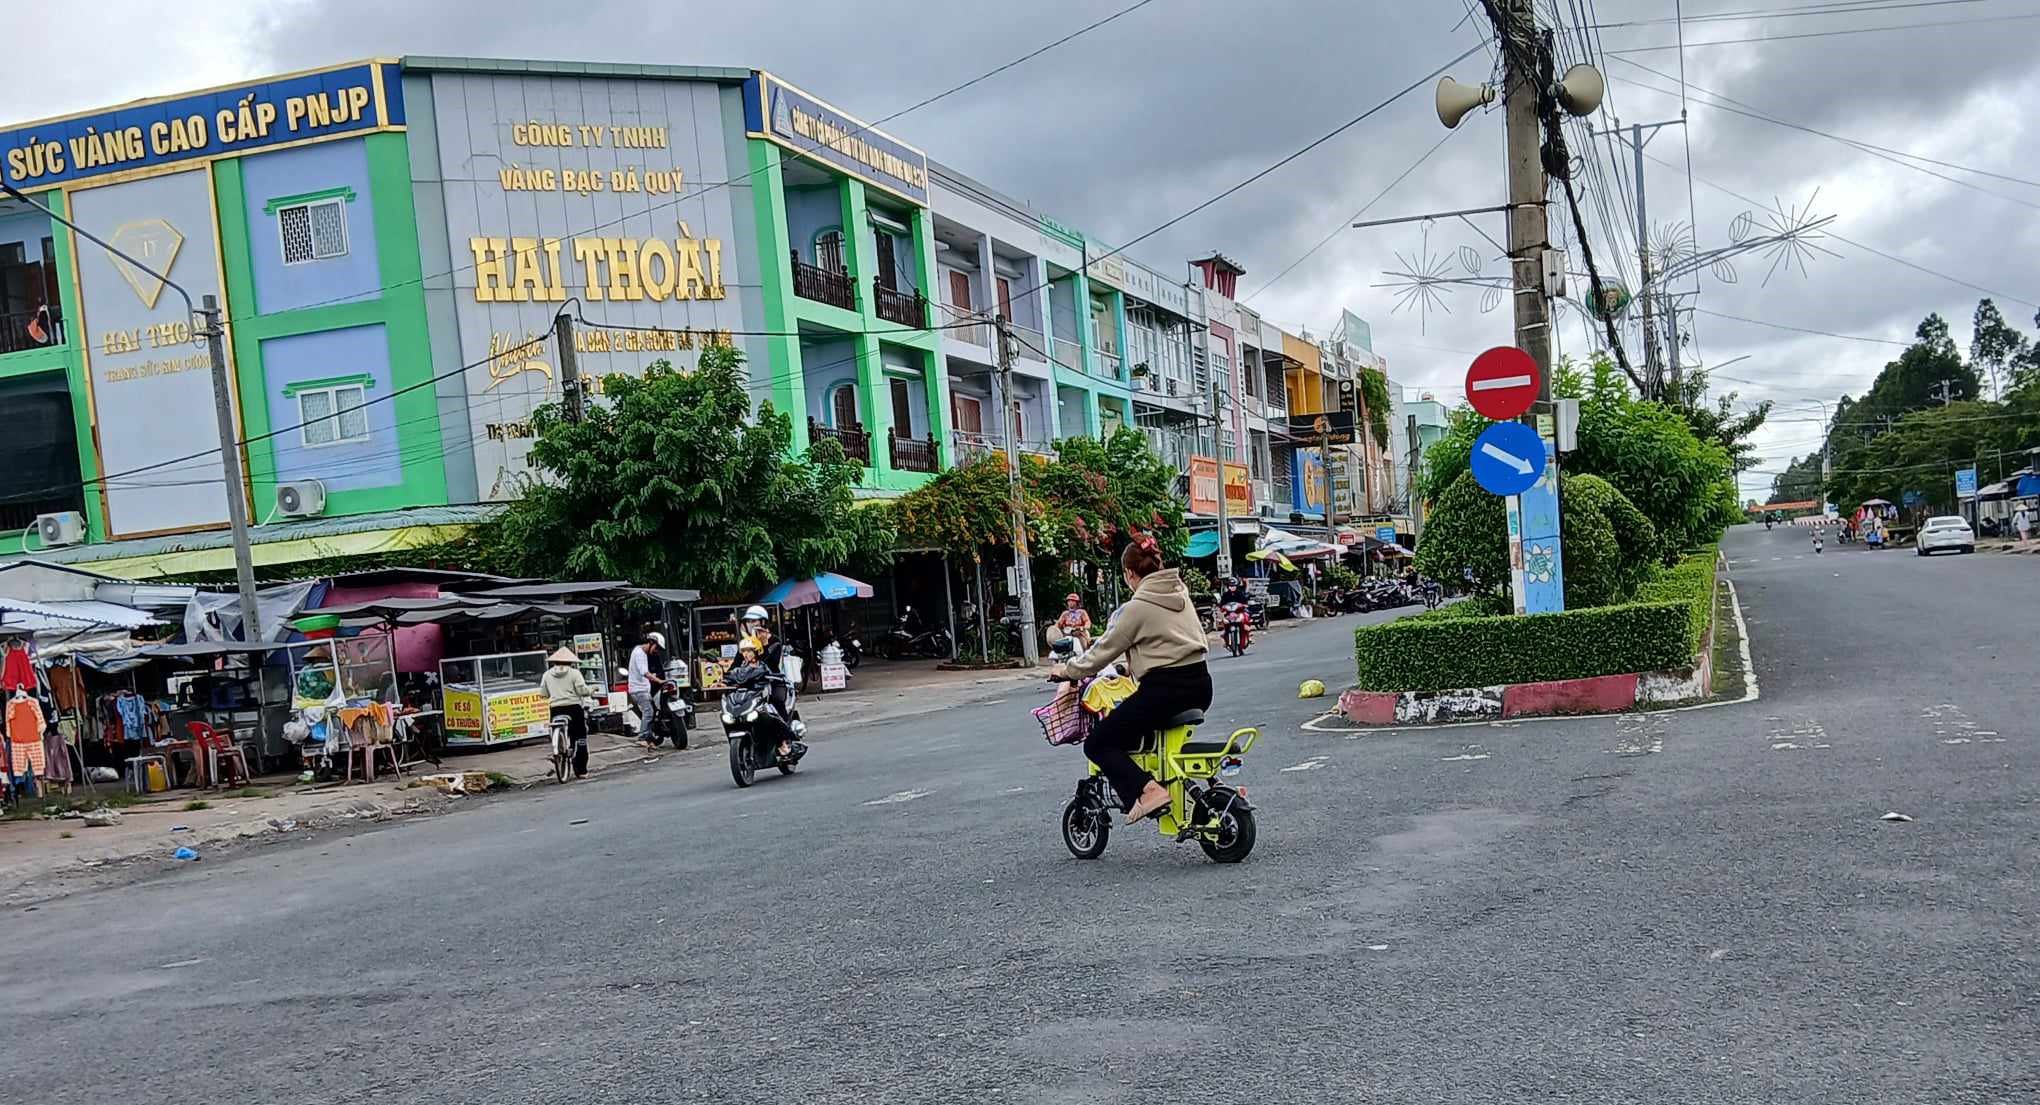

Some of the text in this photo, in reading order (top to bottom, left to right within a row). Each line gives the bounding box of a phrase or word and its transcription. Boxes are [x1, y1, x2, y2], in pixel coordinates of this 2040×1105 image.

[8, 136, 65, 181] SỨC
[69, 126, 145, 171] VÀNG
[150, 115, 207, 156] CAO
[216, 93, 276, 144] CẤP
[286, 86, 369, 131] PNJP
[512, 120, 667, 149] CÔNG TY TNHH
[499, 163, 684, 197] VÀNG BẠC ĐÁ QUÝ
